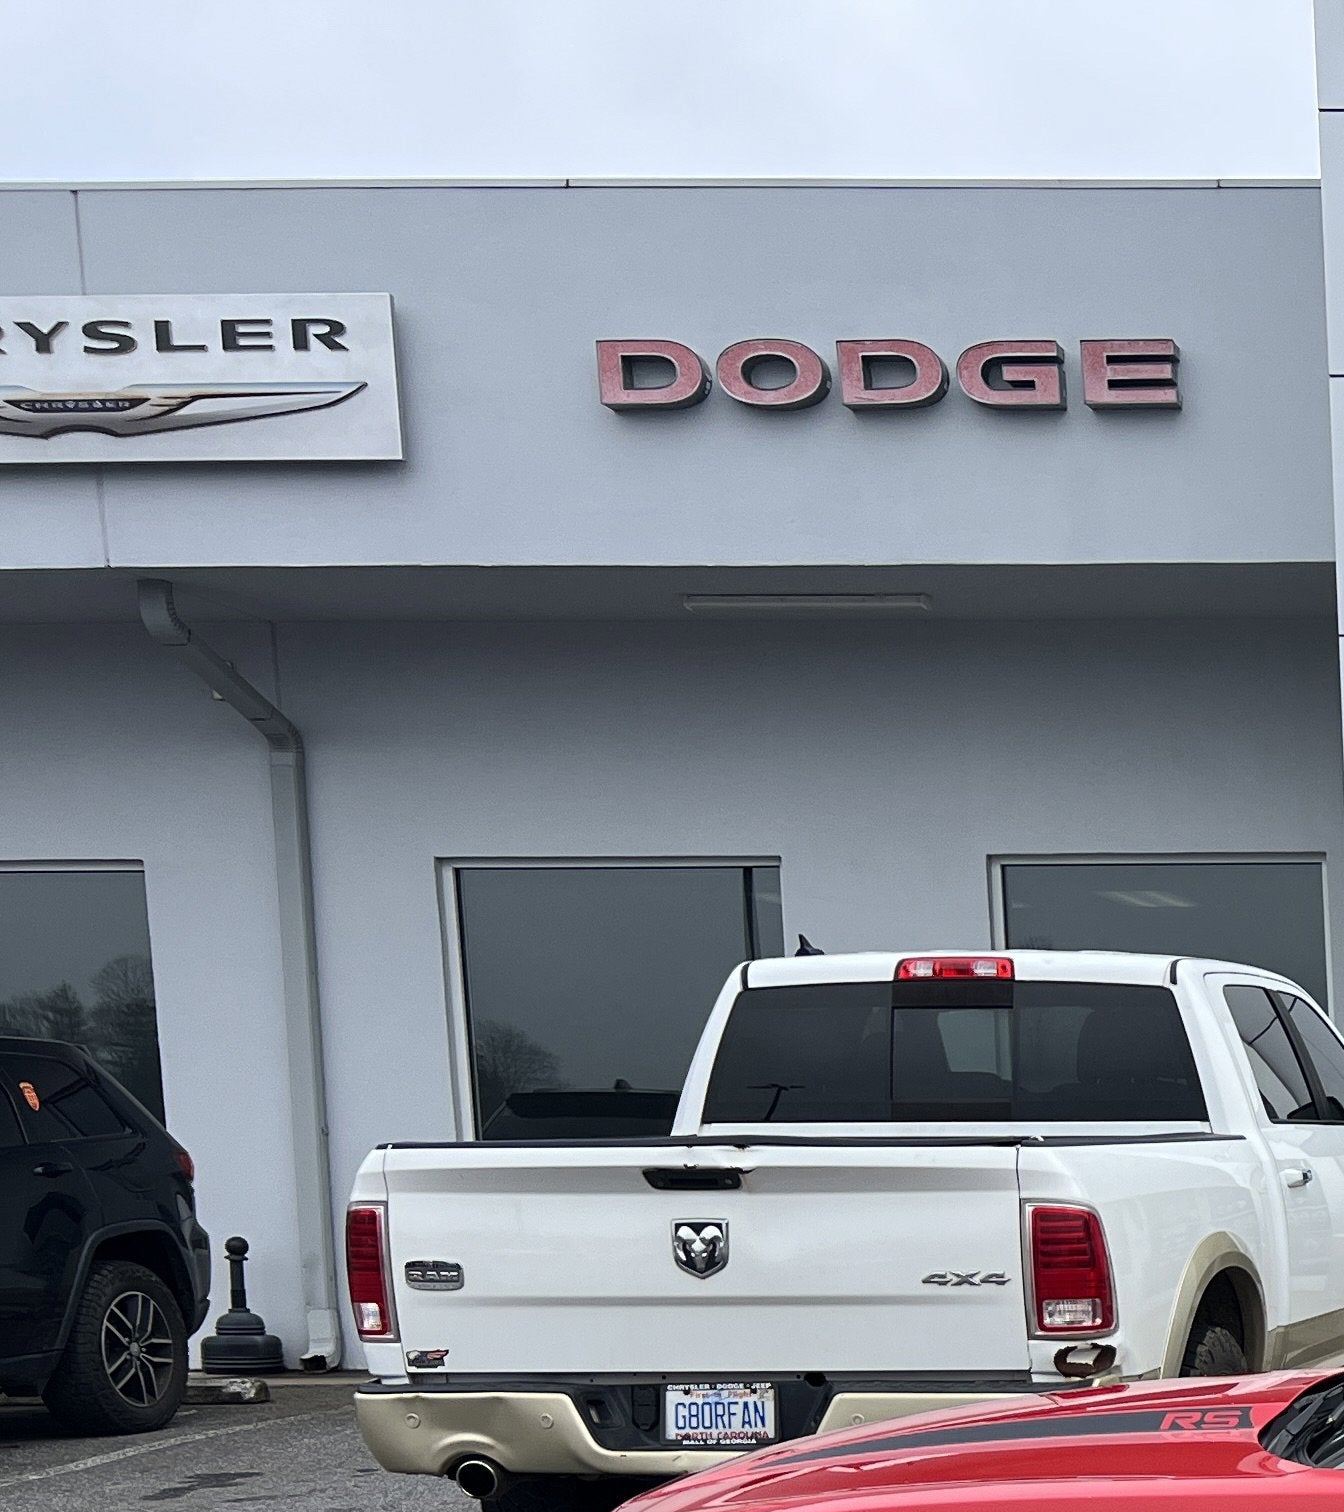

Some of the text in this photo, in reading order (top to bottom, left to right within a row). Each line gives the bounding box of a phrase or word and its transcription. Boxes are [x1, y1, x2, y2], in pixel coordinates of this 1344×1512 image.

[0, 318, 350, 354] YSLER
[595, 338, 1183, 411] DODGE
[409, 1271, 459, 1281] RAM
[1160, 1410, 1242, 1431] RS
